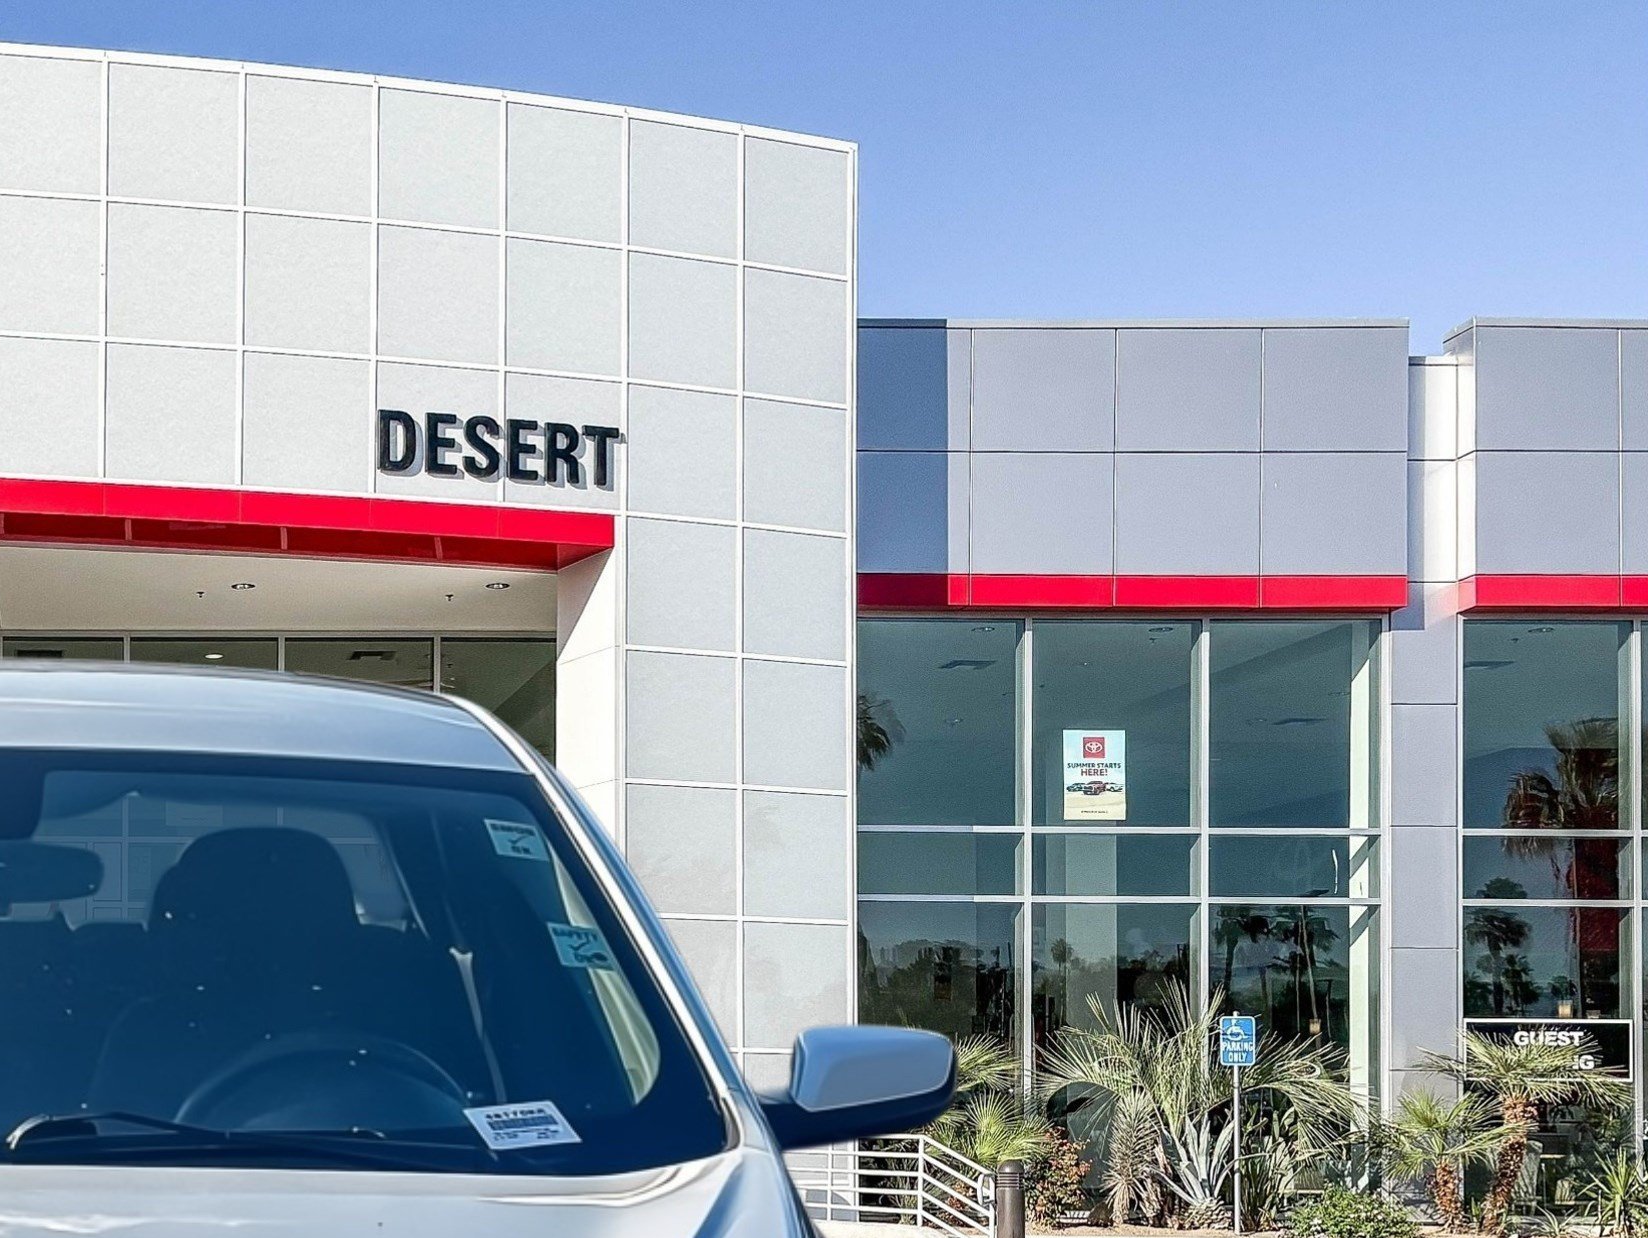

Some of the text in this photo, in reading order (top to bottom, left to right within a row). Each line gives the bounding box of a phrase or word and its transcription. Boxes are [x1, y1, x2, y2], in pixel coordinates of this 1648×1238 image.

[377, 409, 620, 487] DESERT
[1080, 768, 1108, 776] HERE!
[1513, 1030, 1584, 1046] GUEST
[1222, 1041, 1253, 1052] PARKING
[1228, 1051, 1247, 1062] ONLY
